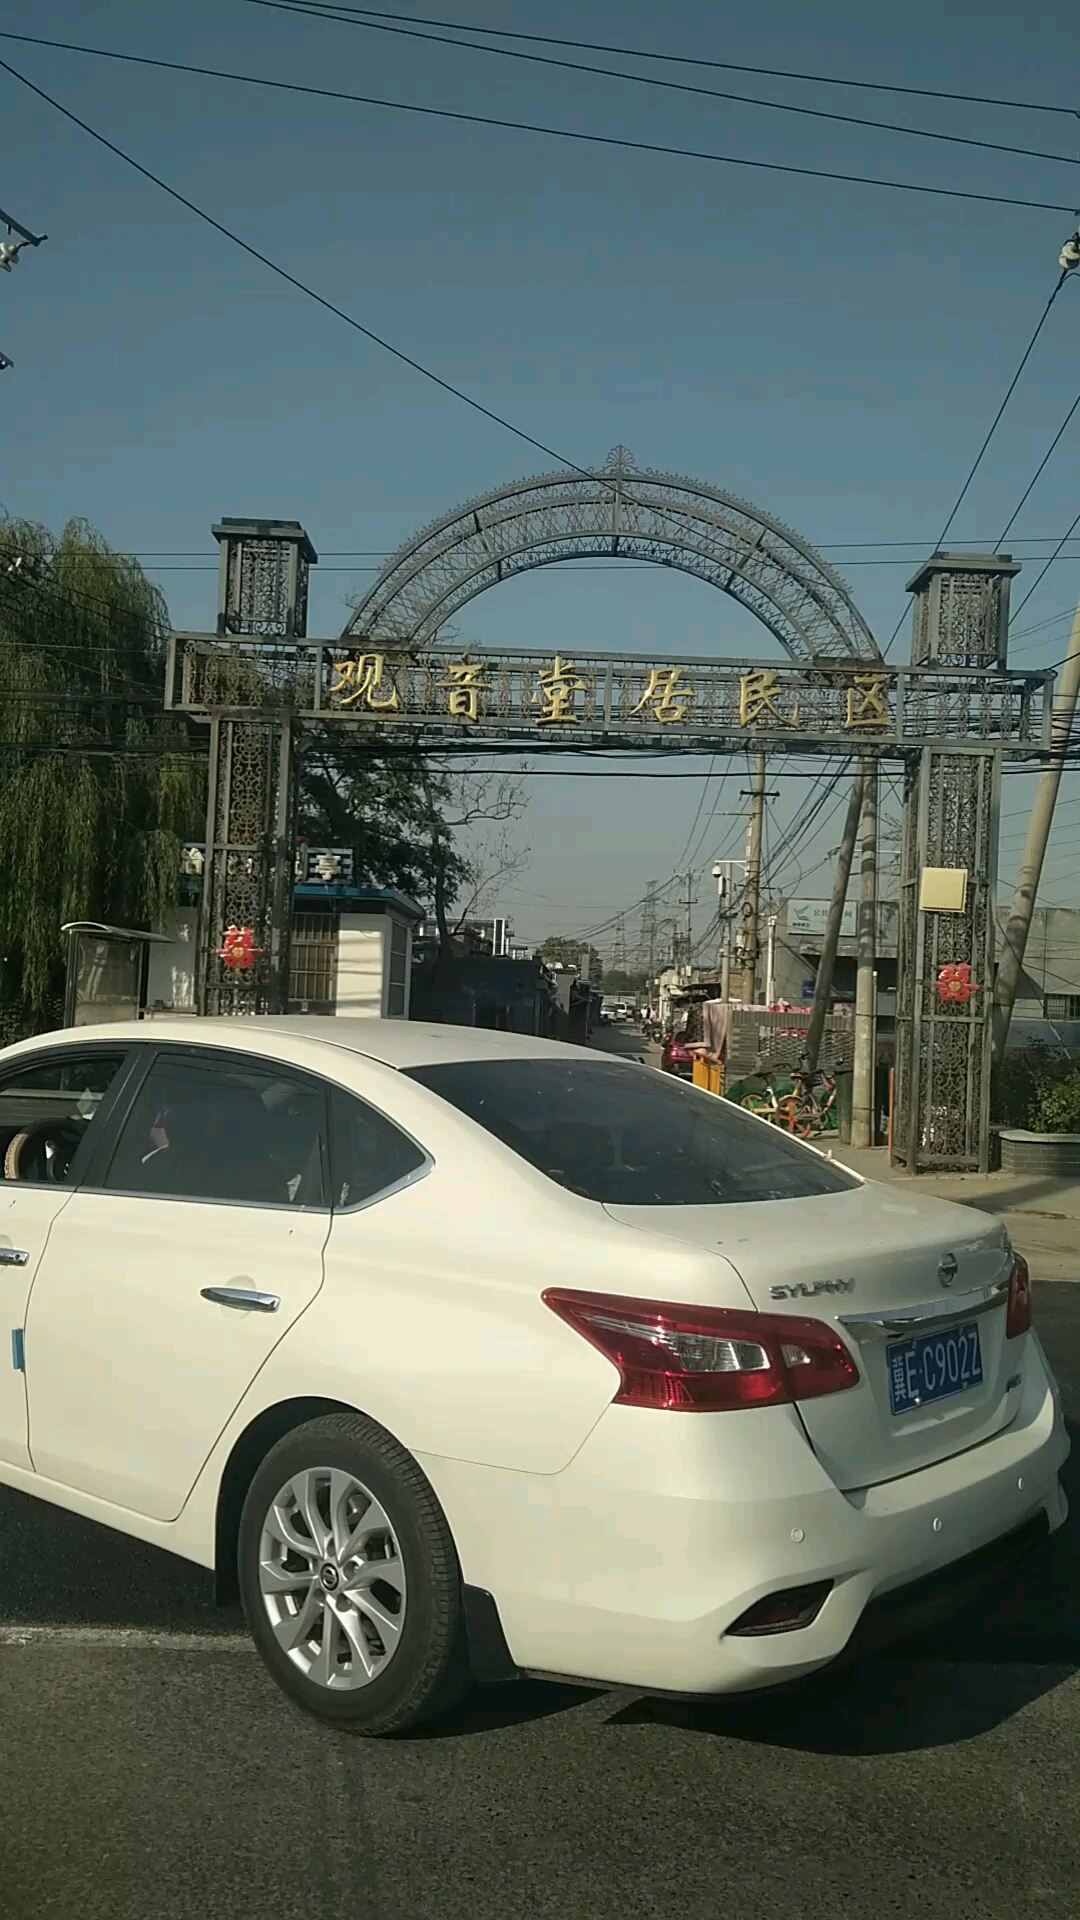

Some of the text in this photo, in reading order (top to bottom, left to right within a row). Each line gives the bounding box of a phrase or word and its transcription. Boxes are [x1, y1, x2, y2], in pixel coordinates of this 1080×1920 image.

[330, 651, 892, 728] 观音堂居民区
[769, 1276, 855, 1300] SYLPHY
